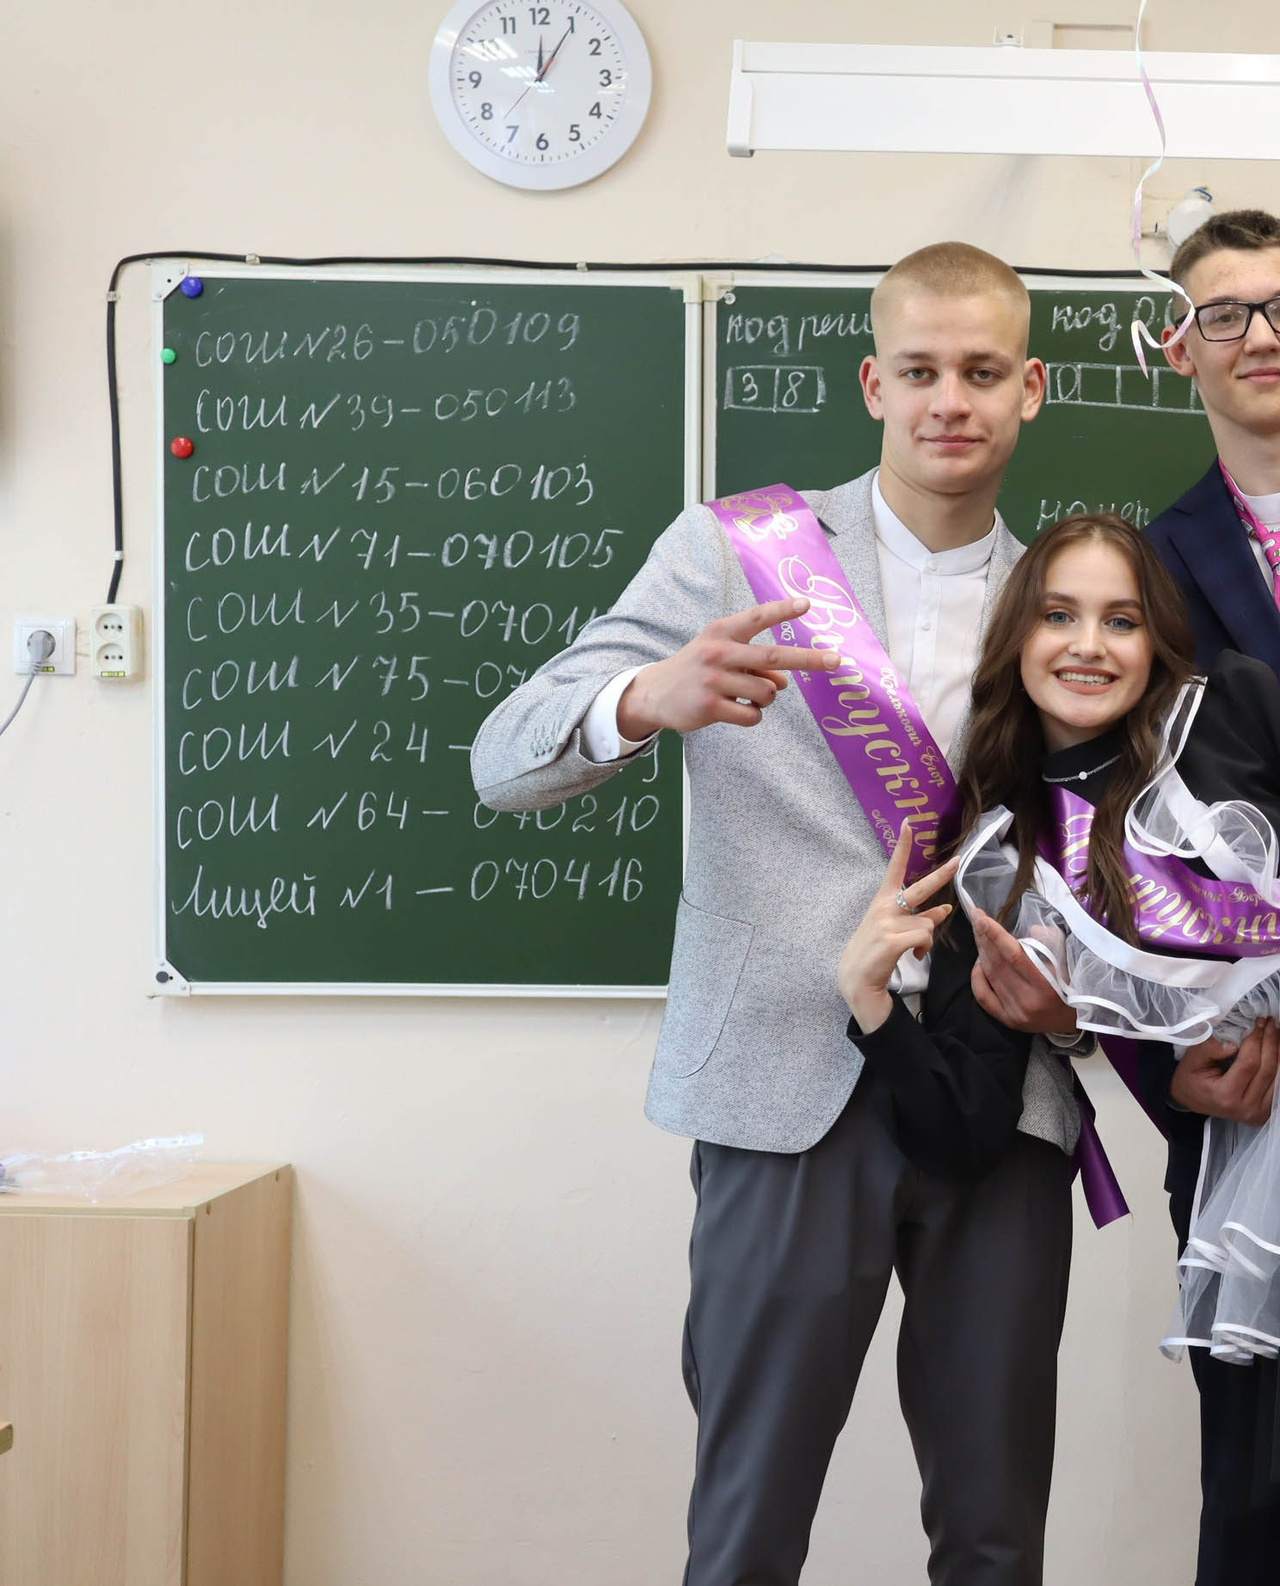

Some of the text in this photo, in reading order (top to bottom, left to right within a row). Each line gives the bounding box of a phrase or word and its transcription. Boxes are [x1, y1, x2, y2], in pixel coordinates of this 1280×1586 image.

[529, 7, 550, 26] 12
[567, 16, 575, 34] 1
[500, 17, 517, 35] 11
[588, 38, 602, 56] 2
[469, 71, 482, 89] 9
[599, 69, 612, 88] 3
[481, 103, 493, 120] 8
[589, 102, 602, 119] 4
[506, 125, 519, 143] 7
[536, 133, 549, 151] 6
[568, 124, 581, 142] 5
[726, 313, 789, 356] код
[1052, 302, 1122, 351] код
[171, 864, 317, 929] Лицей
